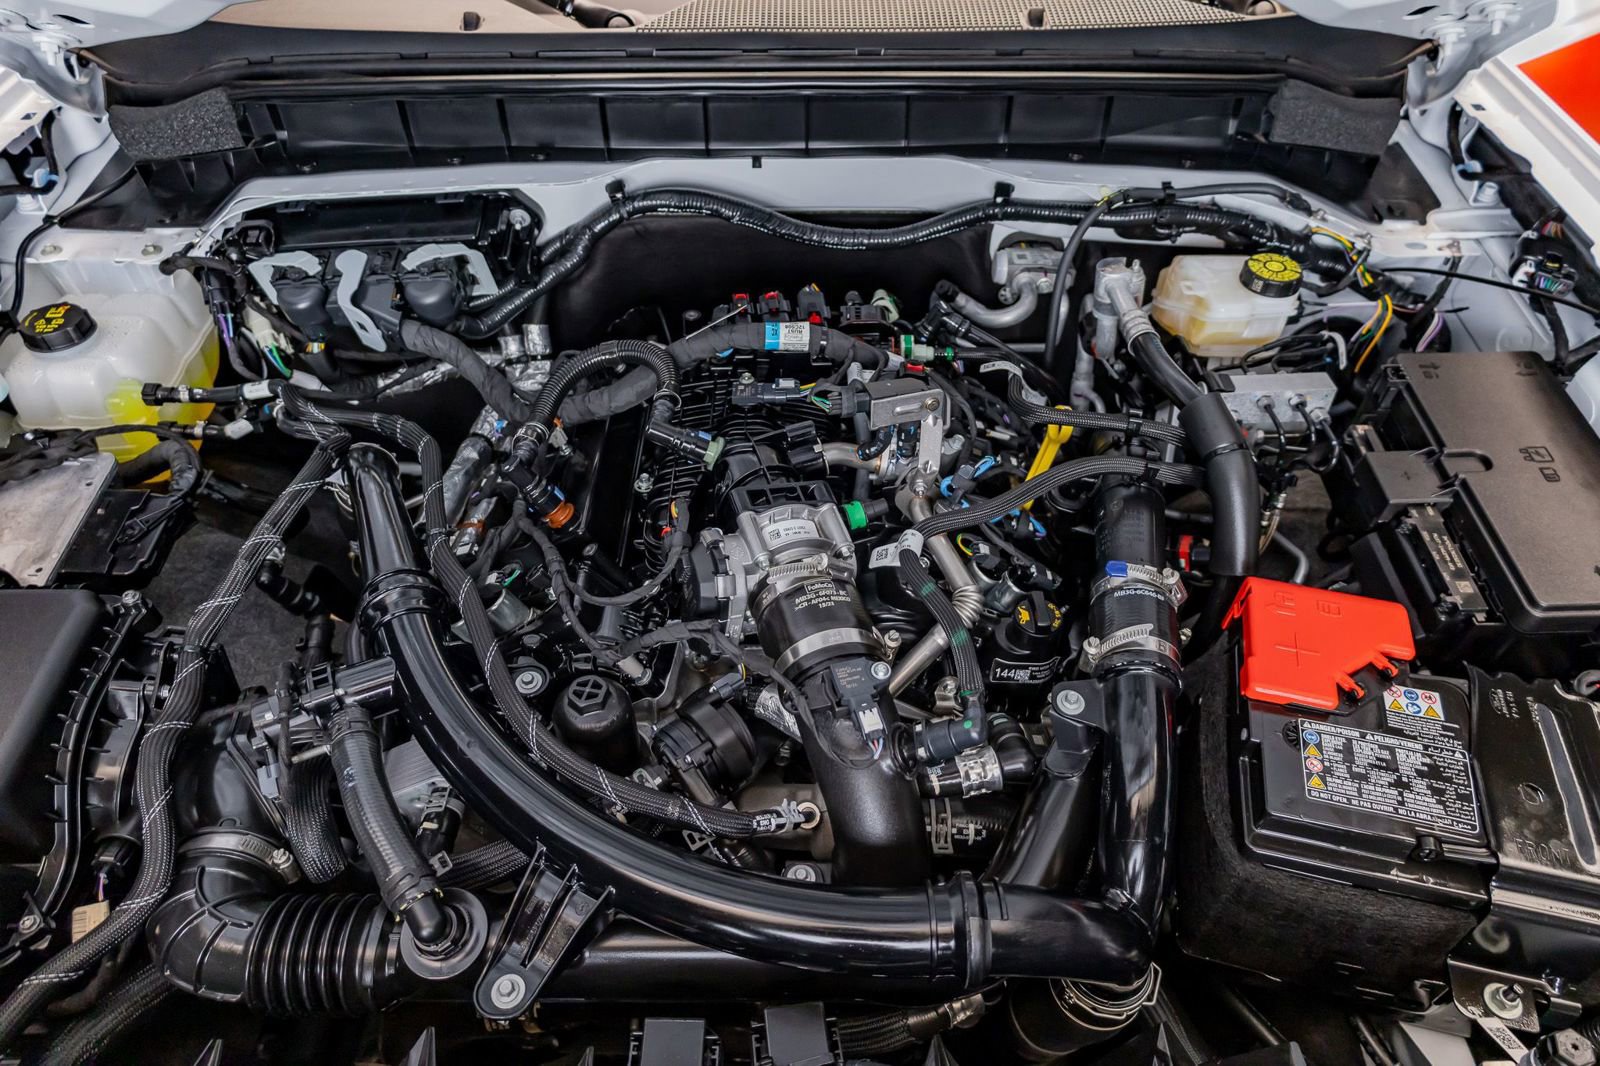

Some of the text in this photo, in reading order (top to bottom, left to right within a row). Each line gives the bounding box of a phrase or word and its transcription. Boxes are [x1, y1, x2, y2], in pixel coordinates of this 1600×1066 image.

[807, 582, 833, 591] FoMoCo
[995, 667, 1015, 678] 144
[1311, 722, 1360, 738] DANGER/POISON
[1320, 791, 1332, 799] NOT
[1351, 798, 1359, 806] NE
[1360, 800, 1371, 808] PAS
[1514, 838, 1570, 865] FRONT
